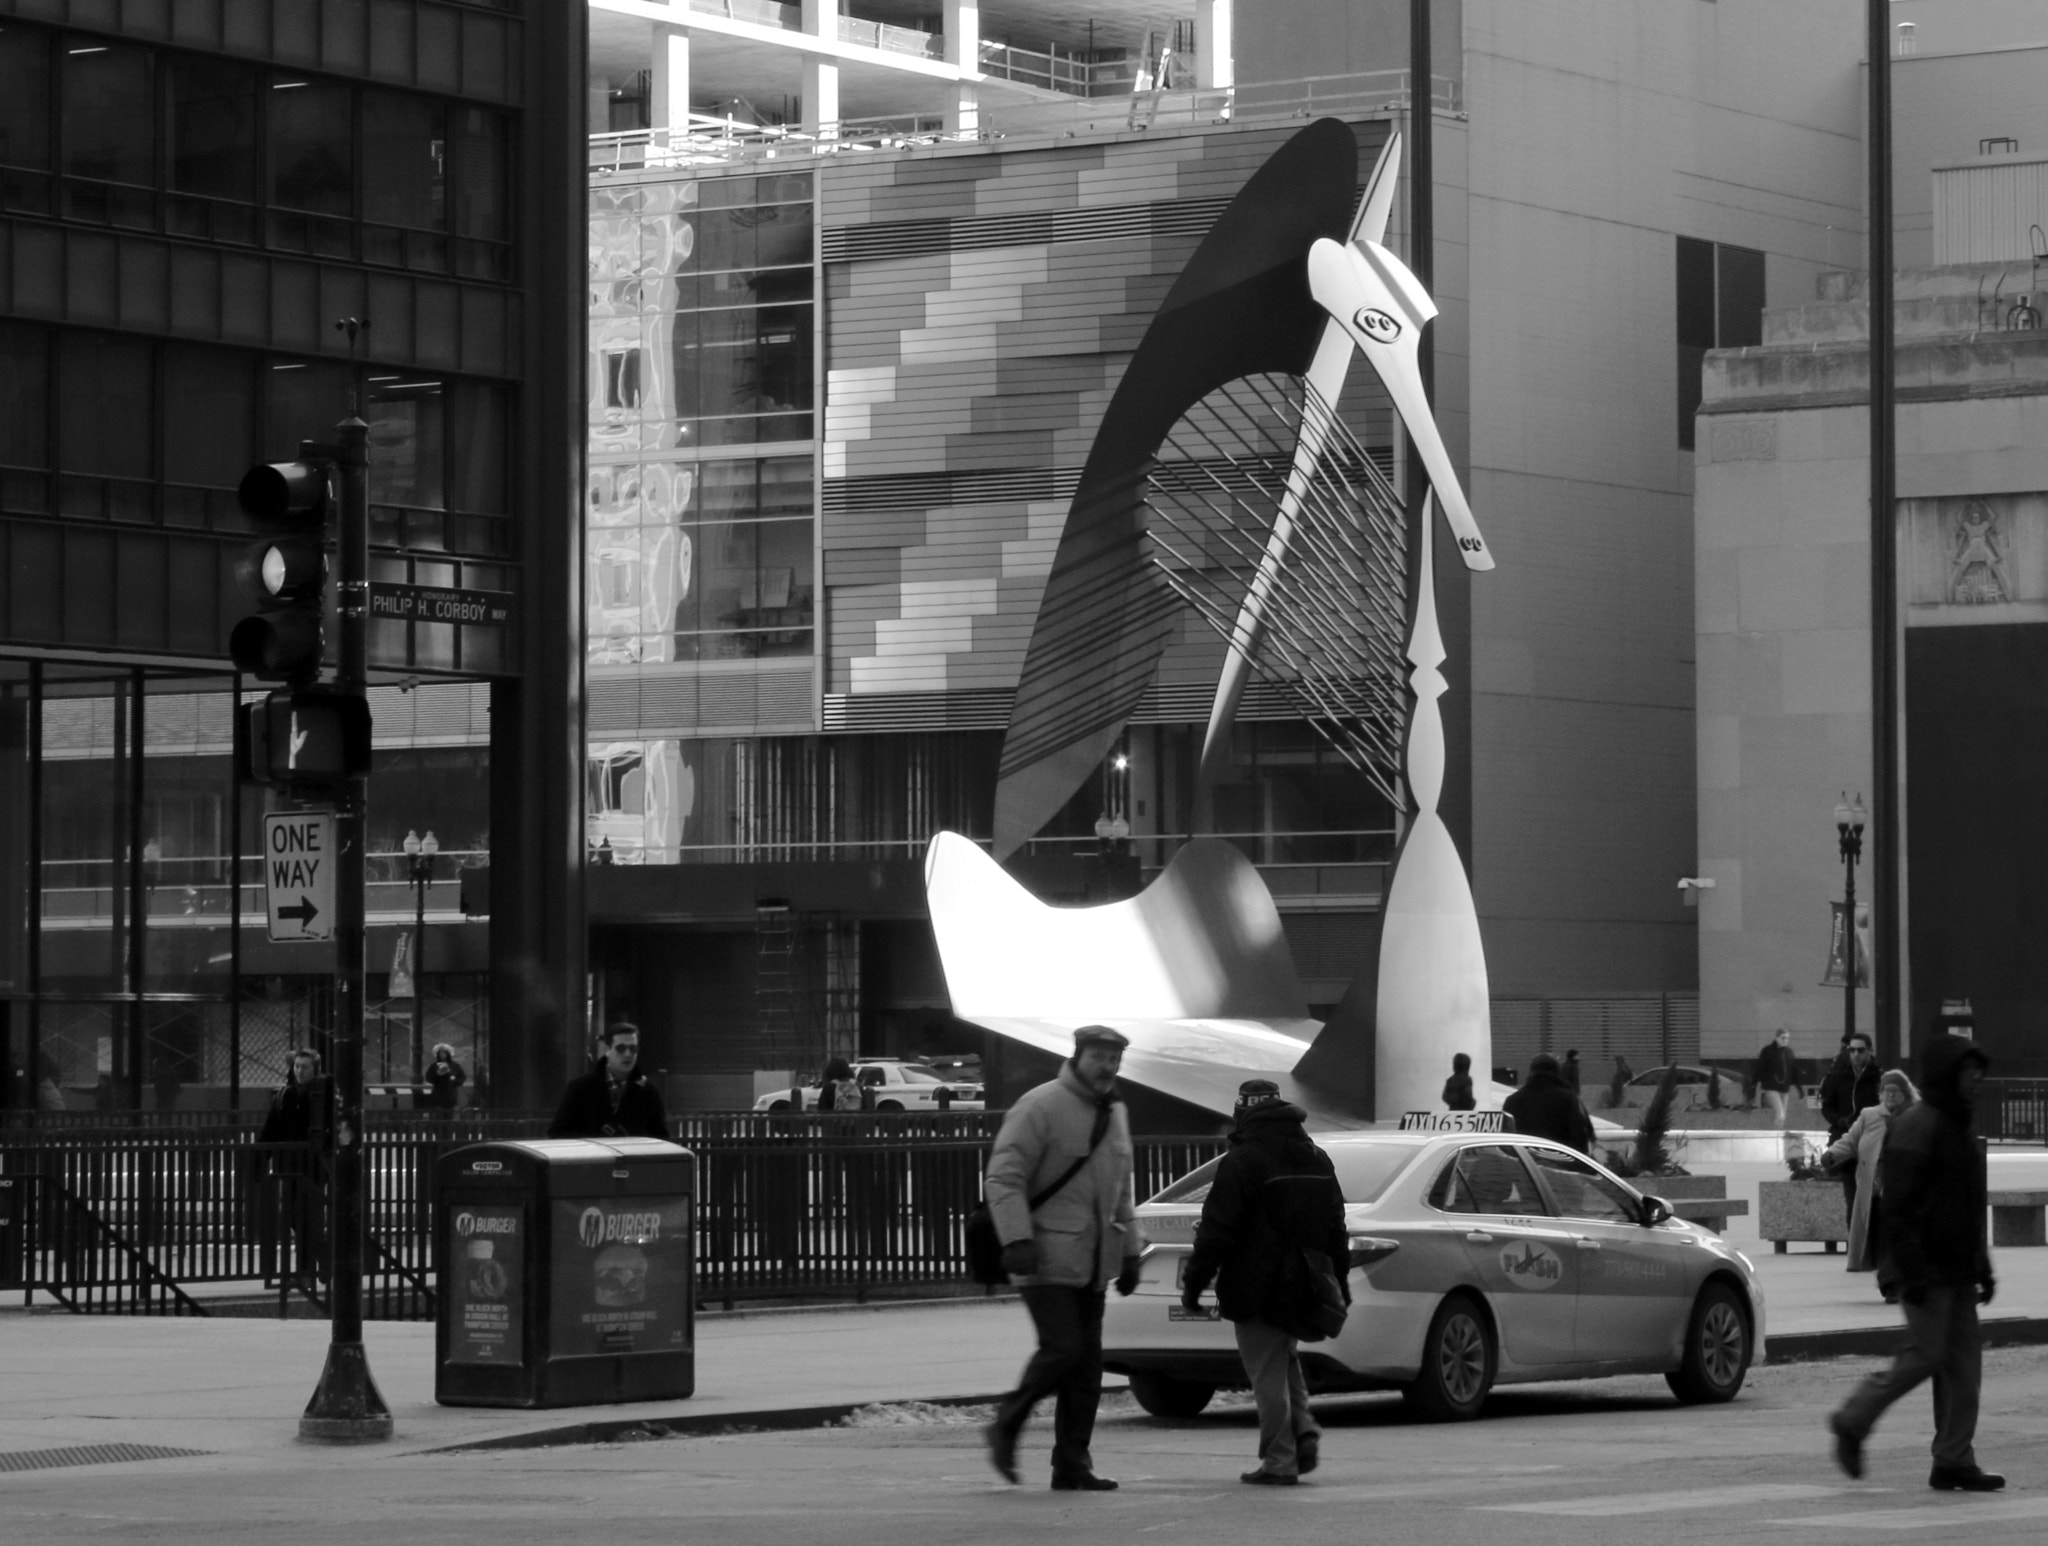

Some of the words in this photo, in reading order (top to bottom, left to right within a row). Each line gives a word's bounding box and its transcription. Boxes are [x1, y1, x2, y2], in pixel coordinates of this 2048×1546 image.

[373, 595, 412, 614] PHILIP
[418, 600, 431, 616] H.
[435, 601, 486, 621] CORBOY
[492, 609, 507, 620] WAY
[272, 823, 321, 853] ONE
[273, 859, 320, 888] WAY
[1404, 1112, 1430, 1130] TAXI
[1432, 1114, 1476, 1132] 1655
[1476, 1112, 1503, 1133] TAXI
[476, 1217, 516, 1233] BURGER
[606, 1213, 661, 1241] BURGER
